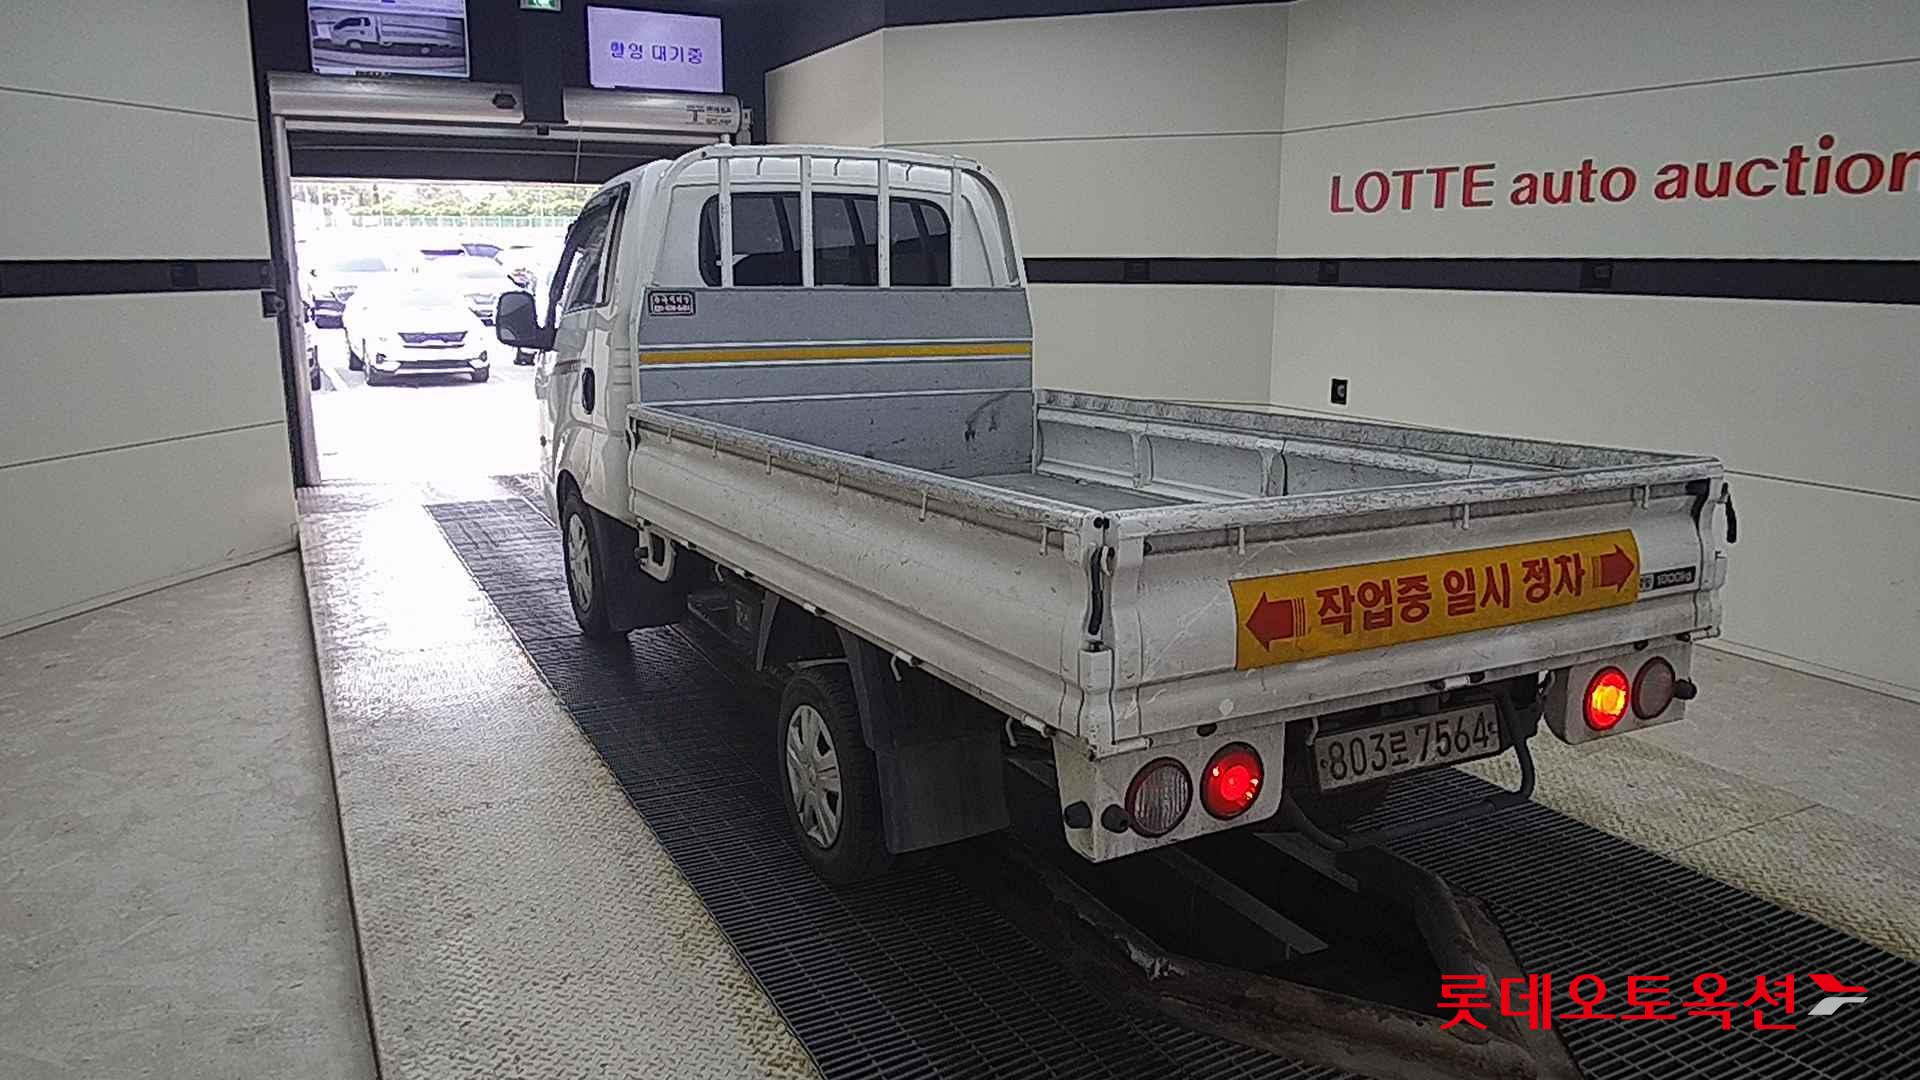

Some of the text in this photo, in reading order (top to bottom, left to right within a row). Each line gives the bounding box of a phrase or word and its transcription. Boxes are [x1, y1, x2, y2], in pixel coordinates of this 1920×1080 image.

[652, 44, 703, 65] 대기중
[1330, 163, 1496, 214] LOTTE
[1510, 159, 1637, 206] auto
[1316, 552, 1586, 634] 작업중 일시 정차
